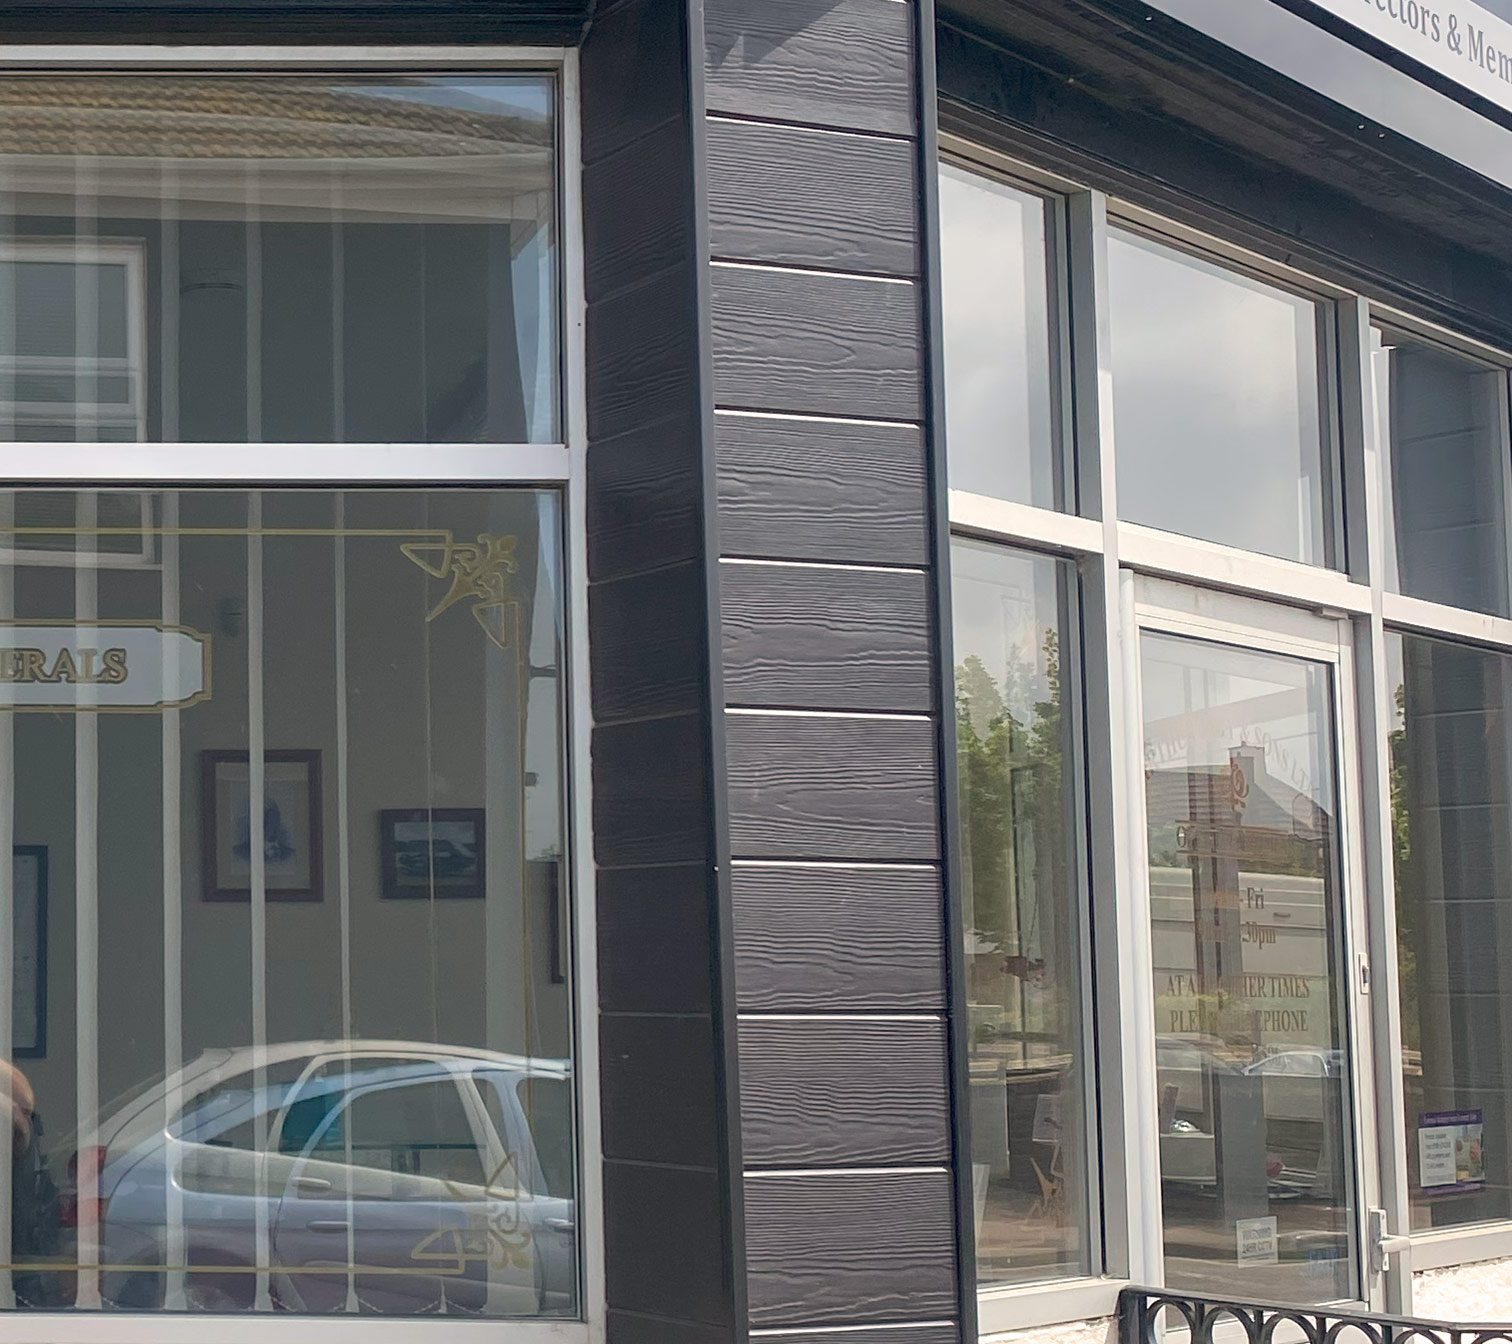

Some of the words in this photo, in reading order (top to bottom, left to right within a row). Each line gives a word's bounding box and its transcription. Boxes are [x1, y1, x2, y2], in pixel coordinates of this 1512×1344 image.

[1446, 14, 1464, 55] &
[1246, 888, 1264, 910] Fri
[1167, 975, 1185, 997] AT
[1268, 976, 1311, 999] TIMES
